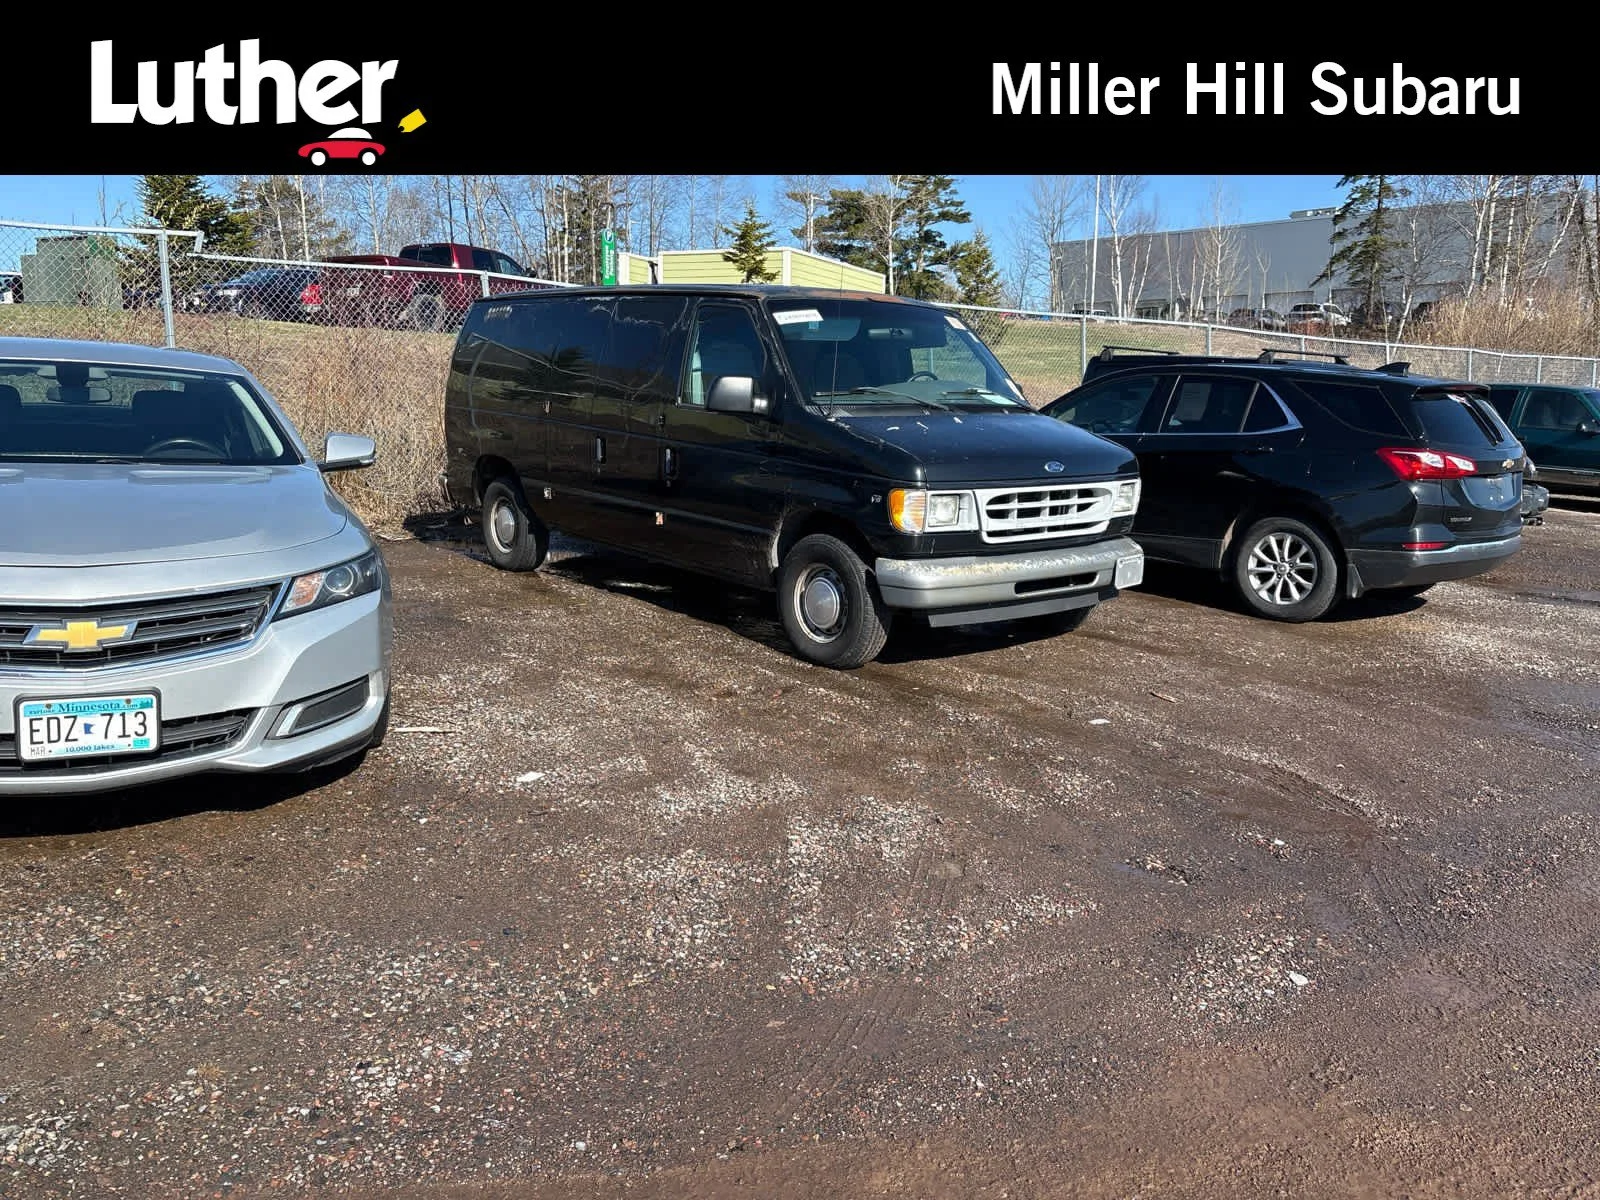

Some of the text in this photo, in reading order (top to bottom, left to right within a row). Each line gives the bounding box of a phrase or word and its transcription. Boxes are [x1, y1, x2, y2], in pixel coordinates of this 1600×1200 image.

[58, 701, 120, 713] Minnesota
[29, 711, 148, 745] EDZ 713
